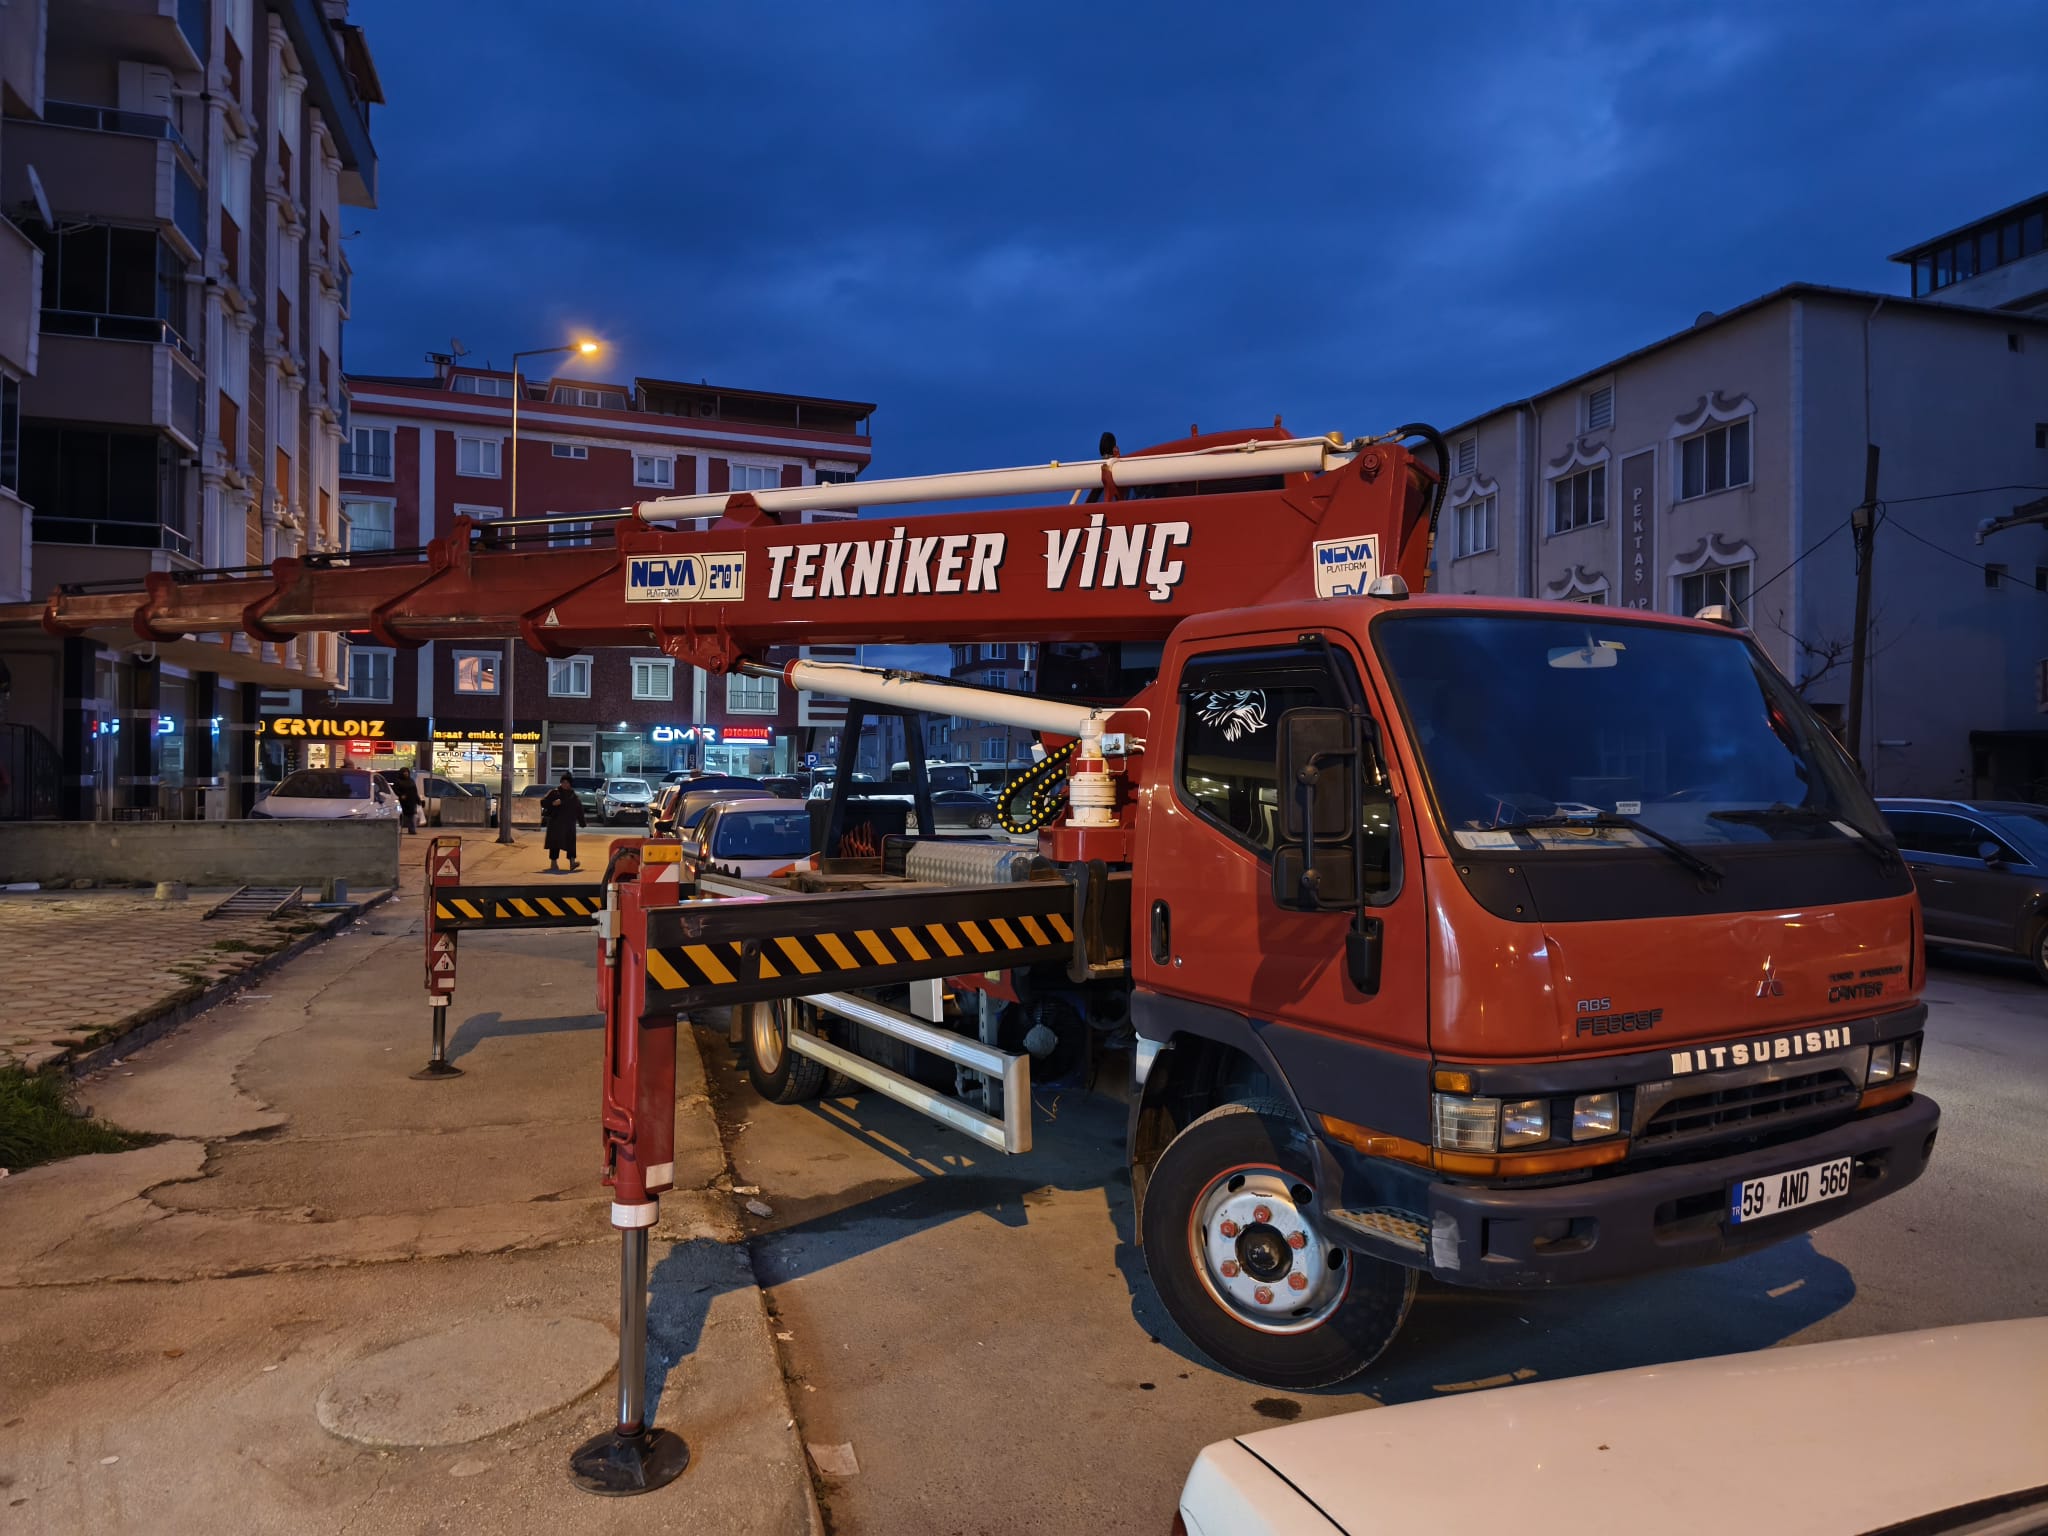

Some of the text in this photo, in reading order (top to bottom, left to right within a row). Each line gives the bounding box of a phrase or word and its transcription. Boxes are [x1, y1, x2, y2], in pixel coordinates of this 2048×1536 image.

[1633, 487, 1643, 584] PEKTAŞ
[767, 513, 1191, 602] TEKNİKER VİNÇ
[1319, 543, 1373, 565] NOVA
[631, 559, 696, 587] NOVA
[709, 564, 742, 589] 270 T
[1326, 561, 1367, 574] PLATFORM
[646, 588, 679, 598] PLATFORM
[273, 718, 385, 737] ERYILDIZ
[467, 731, 497, 740] emlak
[807, 754, 817, 766] P
[1577, 997, 1611, 1013] ABS
[1671, 1026, 1851, 1075] MITSUBISHI
[1743, 1161, 1849, 1217] 59 AND 566
[1732, 1206, 1741, 1216] TR
